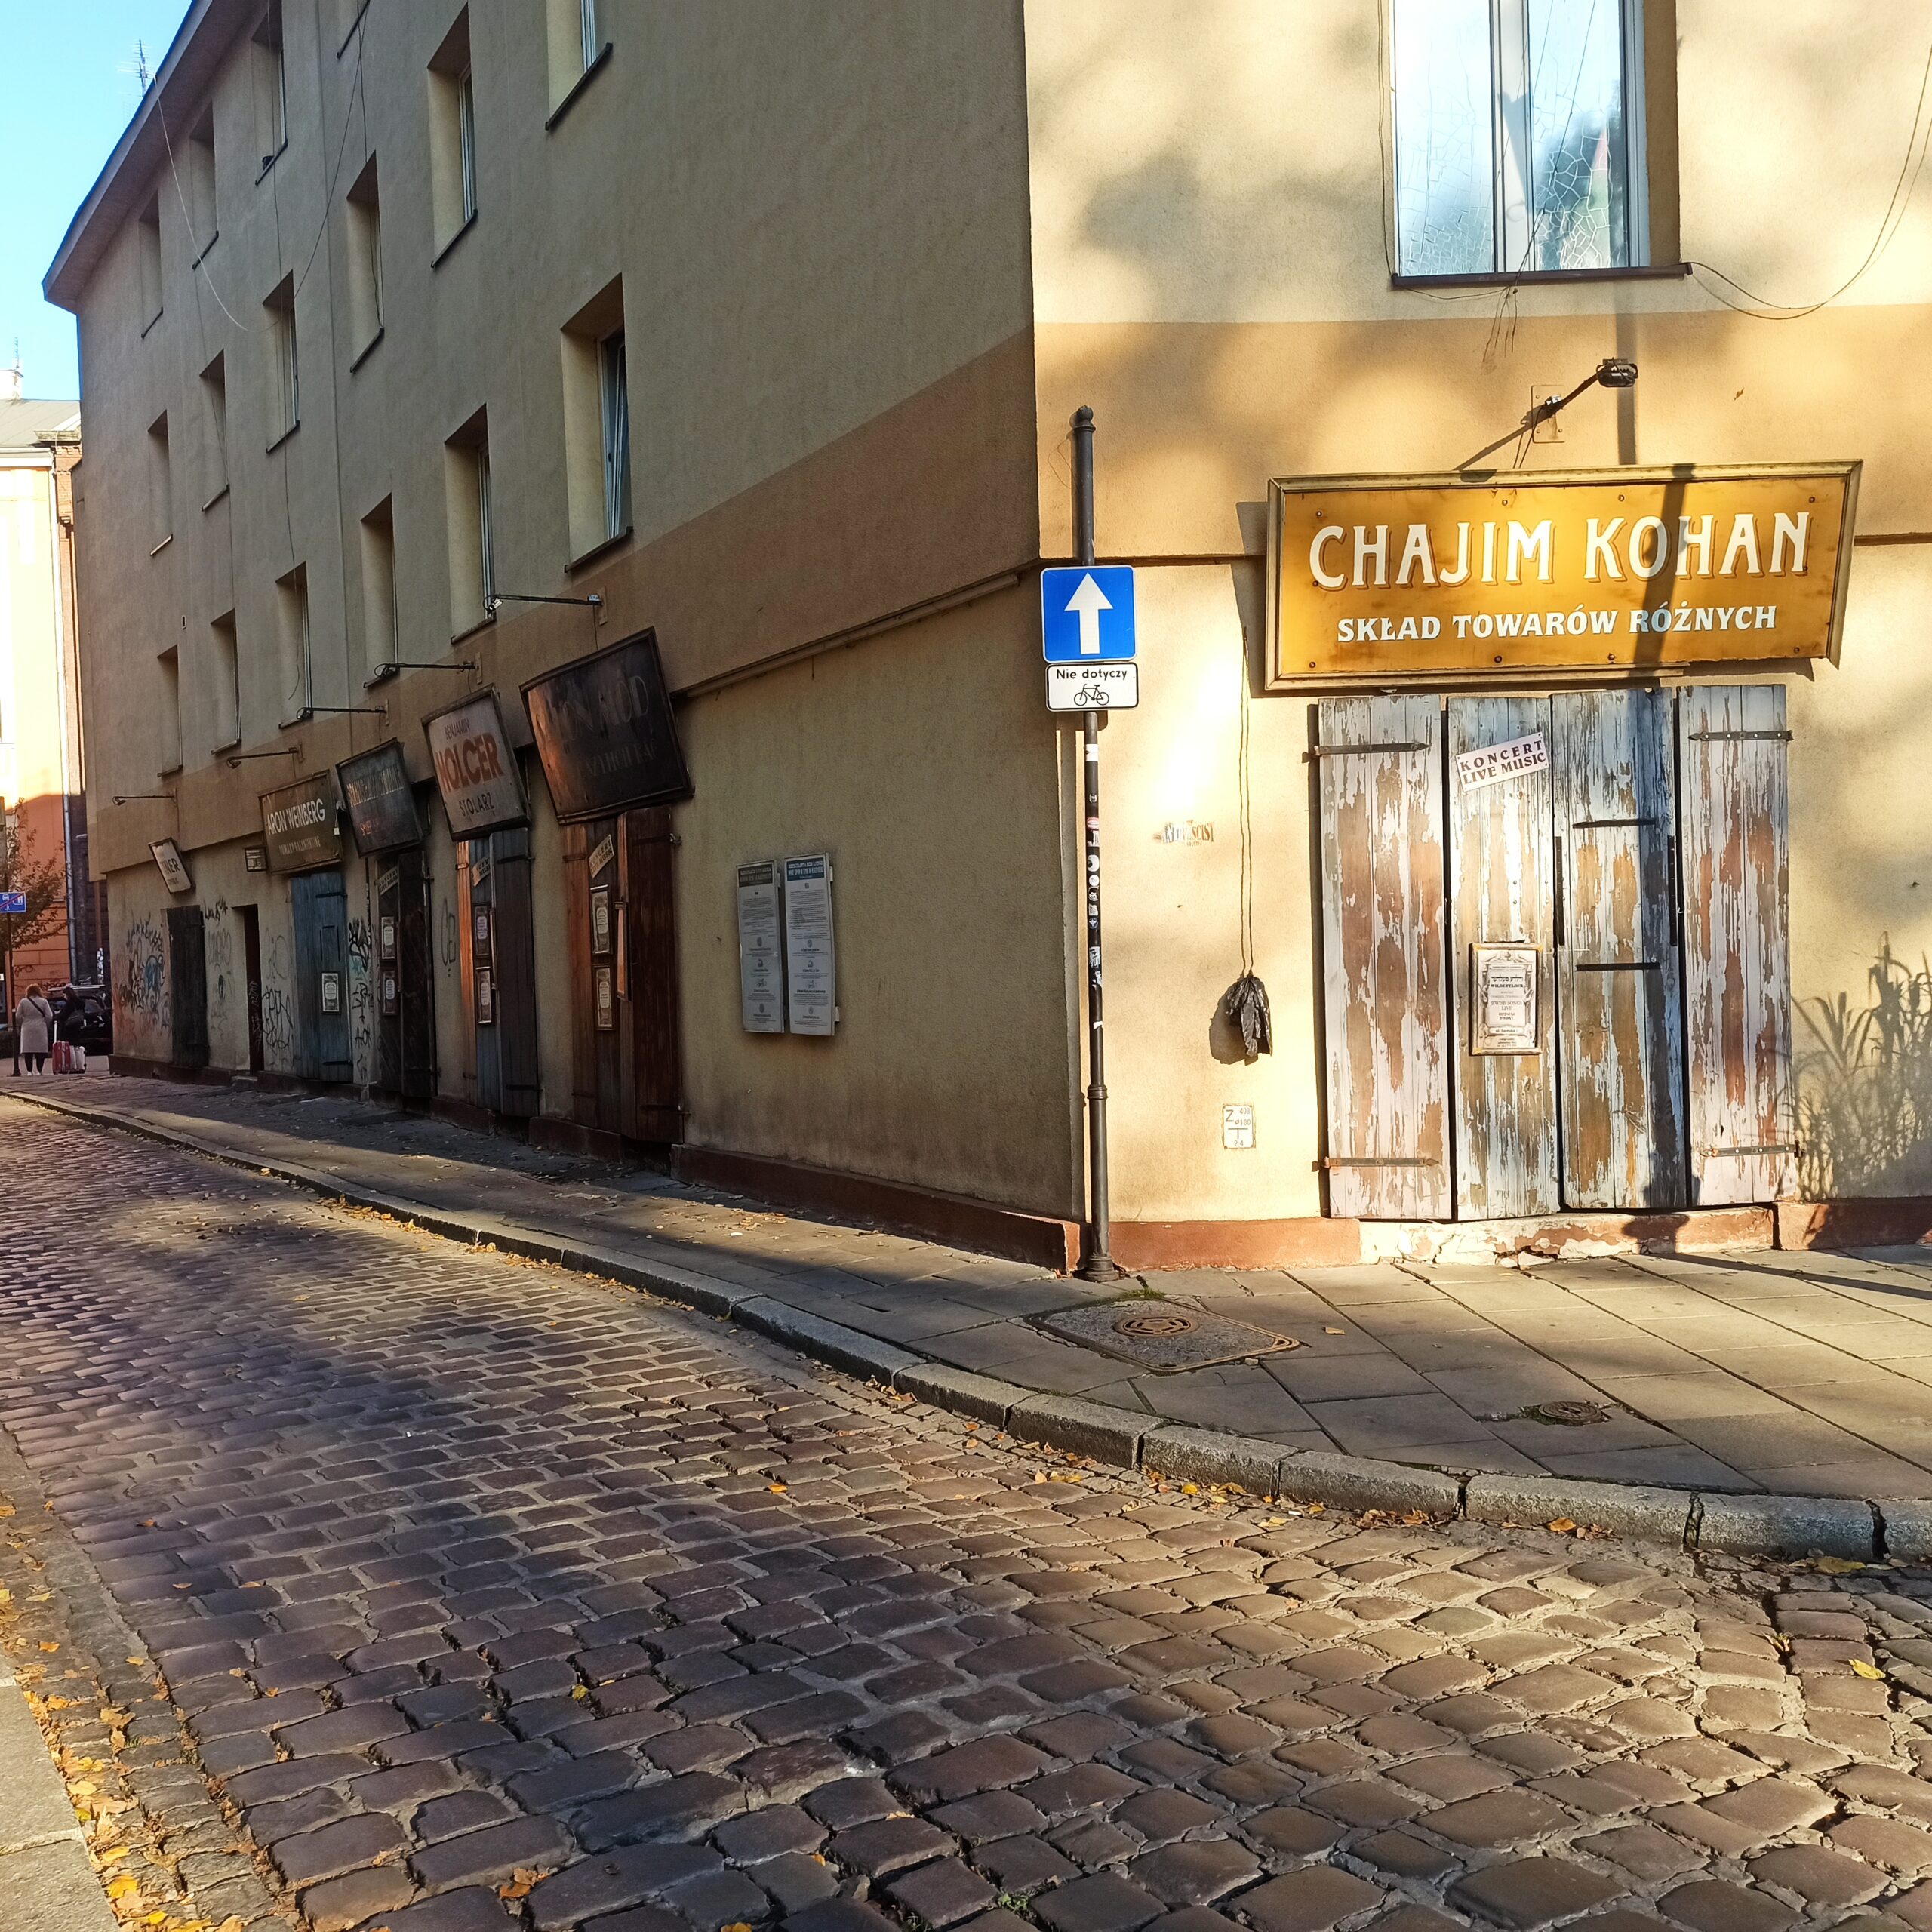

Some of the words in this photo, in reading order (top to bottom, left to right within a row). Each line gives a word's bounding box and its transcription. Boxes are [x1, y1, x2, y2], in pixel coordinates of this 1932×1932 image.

[1309, 520, 1554, 588] CHAJIM
[1583, 512, 1810, 579] KOHAN
[1337, 614, 1442, 642] SKŁAD
[1451, 603, 1620, 638] TOWARÓW
[1629, 600, 1778, 632] RÓŻNYCH
[1057, 669, 1077, 679] Nie
[1081, 669, 1128, 681] dotyczy
[445, 719, 470, 739] BENJAMIN
[435, 733, 504, 792] HOLCER
[1460, 740, 1543, 772] KONCERT
[1463, 766, 1497, 785] LIVE
[1501, 752, 1546, 774] MUSIC
[267, 810, 288, 835] ARON
[285, 798, 325, 829] WEINBERG
[459, 792, 494, 816] STOLARZ
[1226, 1109, 1234, 1122] Z
